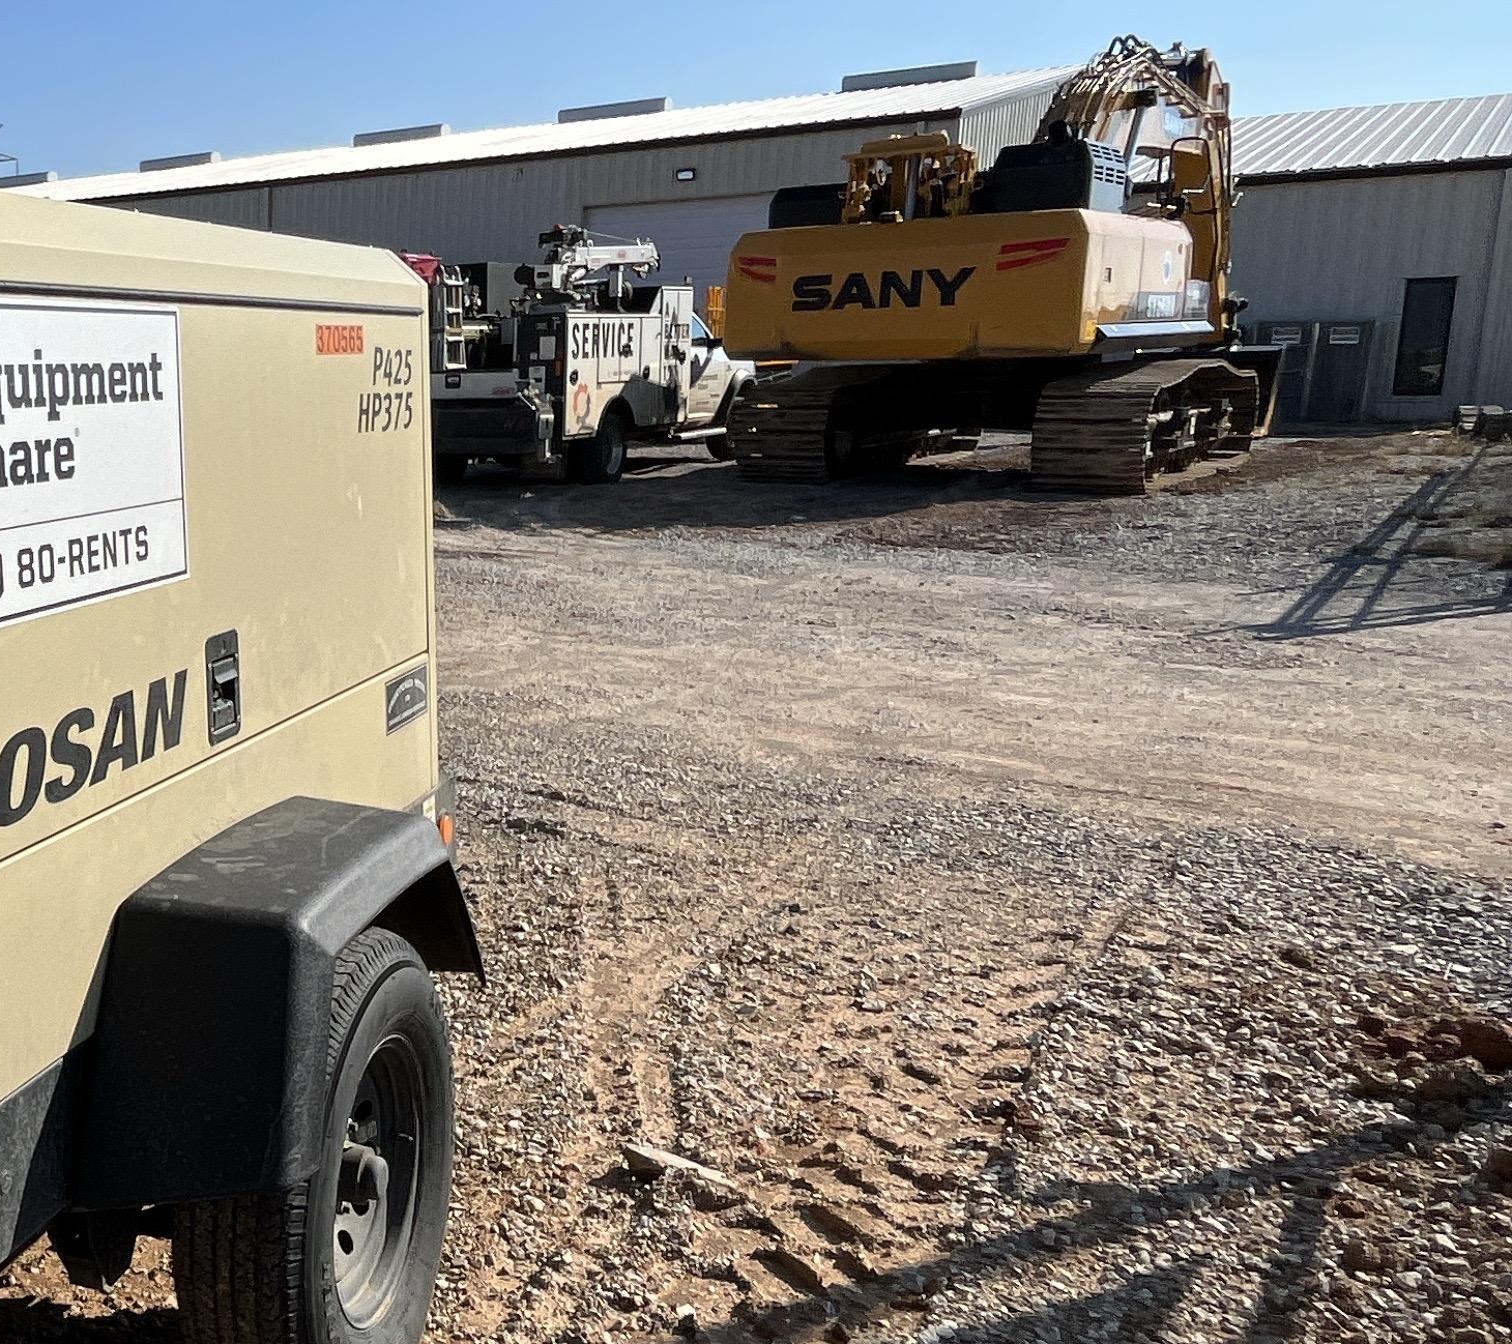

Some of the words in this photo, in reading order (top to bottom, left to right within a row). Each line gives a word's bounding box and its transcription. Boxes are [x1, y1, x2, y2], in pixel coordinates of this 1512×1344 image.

[791, 265, 978, 313] SANY
[316, 325, 364, 354] 370565
[571, 322, 635, 360] SERVICE
[372, 346, 413, 388] P425
[357, 391, 414, 434] HP375
[17, 524, 150, 590] 80-RENTS
